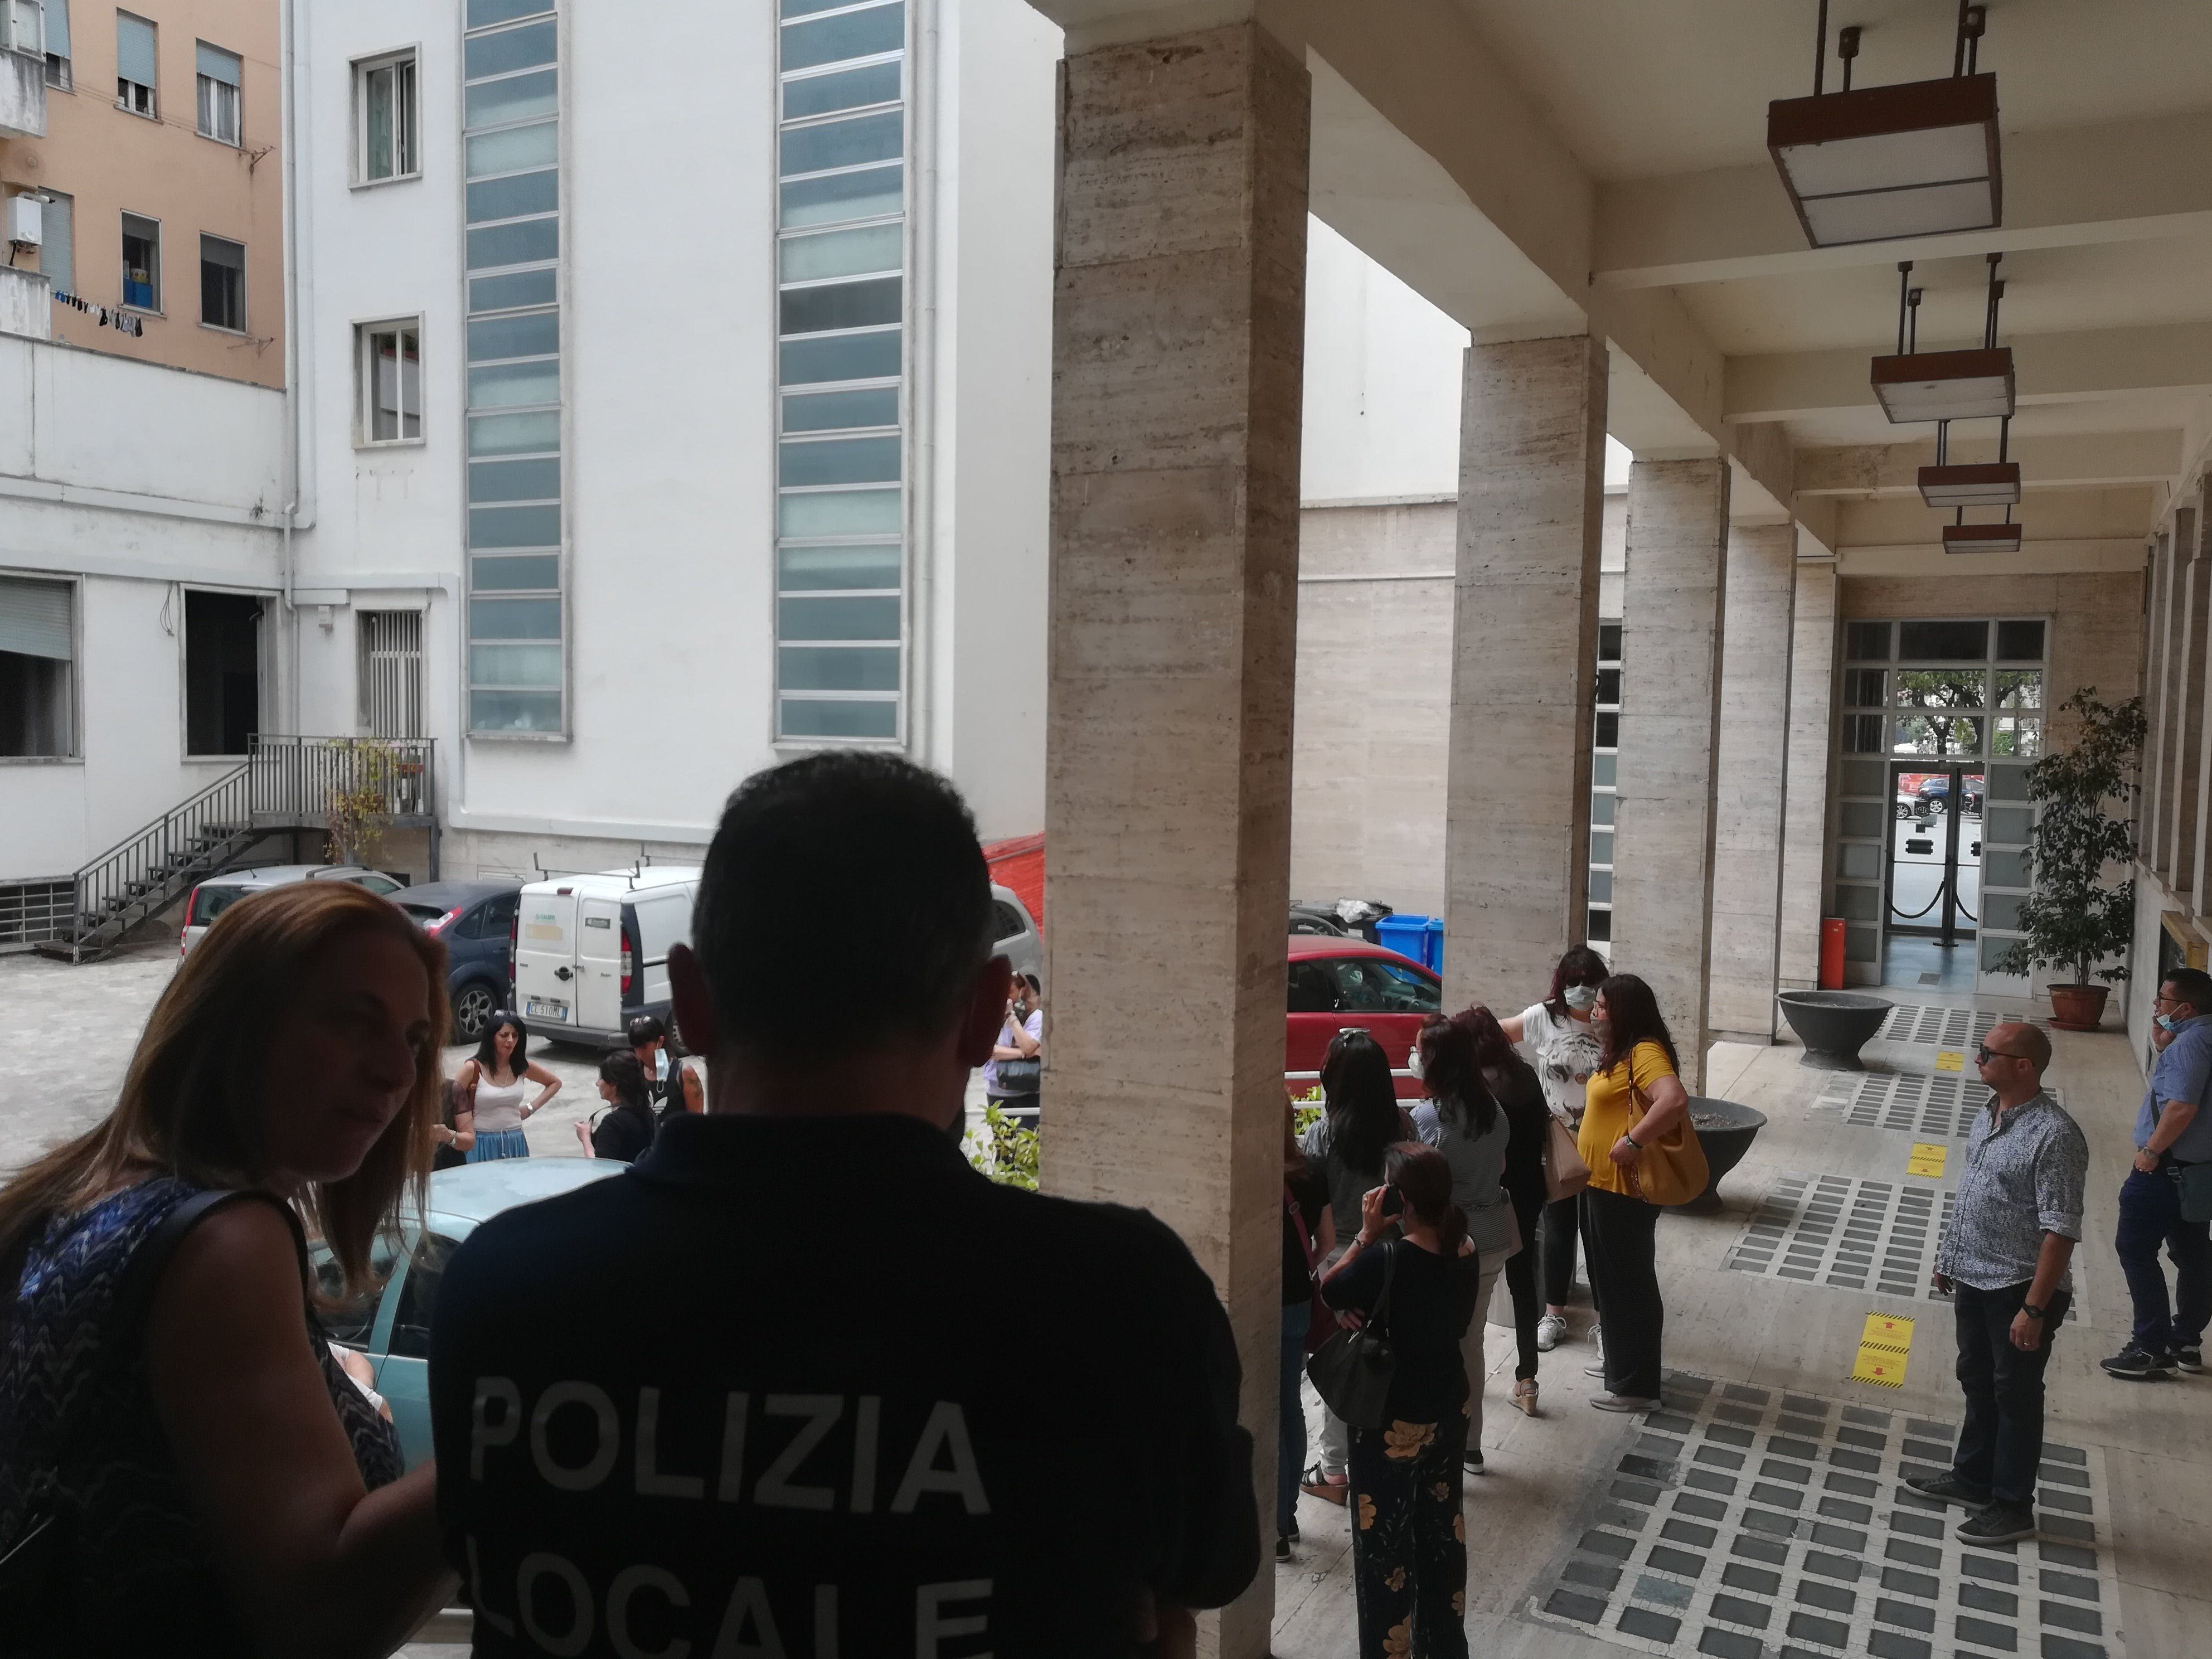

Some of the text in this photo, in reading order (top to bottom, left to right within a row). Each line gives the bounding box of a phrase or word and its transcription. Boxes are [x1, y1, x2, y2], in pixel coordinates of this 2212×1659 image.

[531, 1003, 538, 1013] CL
[469, 1375, 992, 1515] POLIZIA
[465, 1534, 994, 1659] LOCALE
